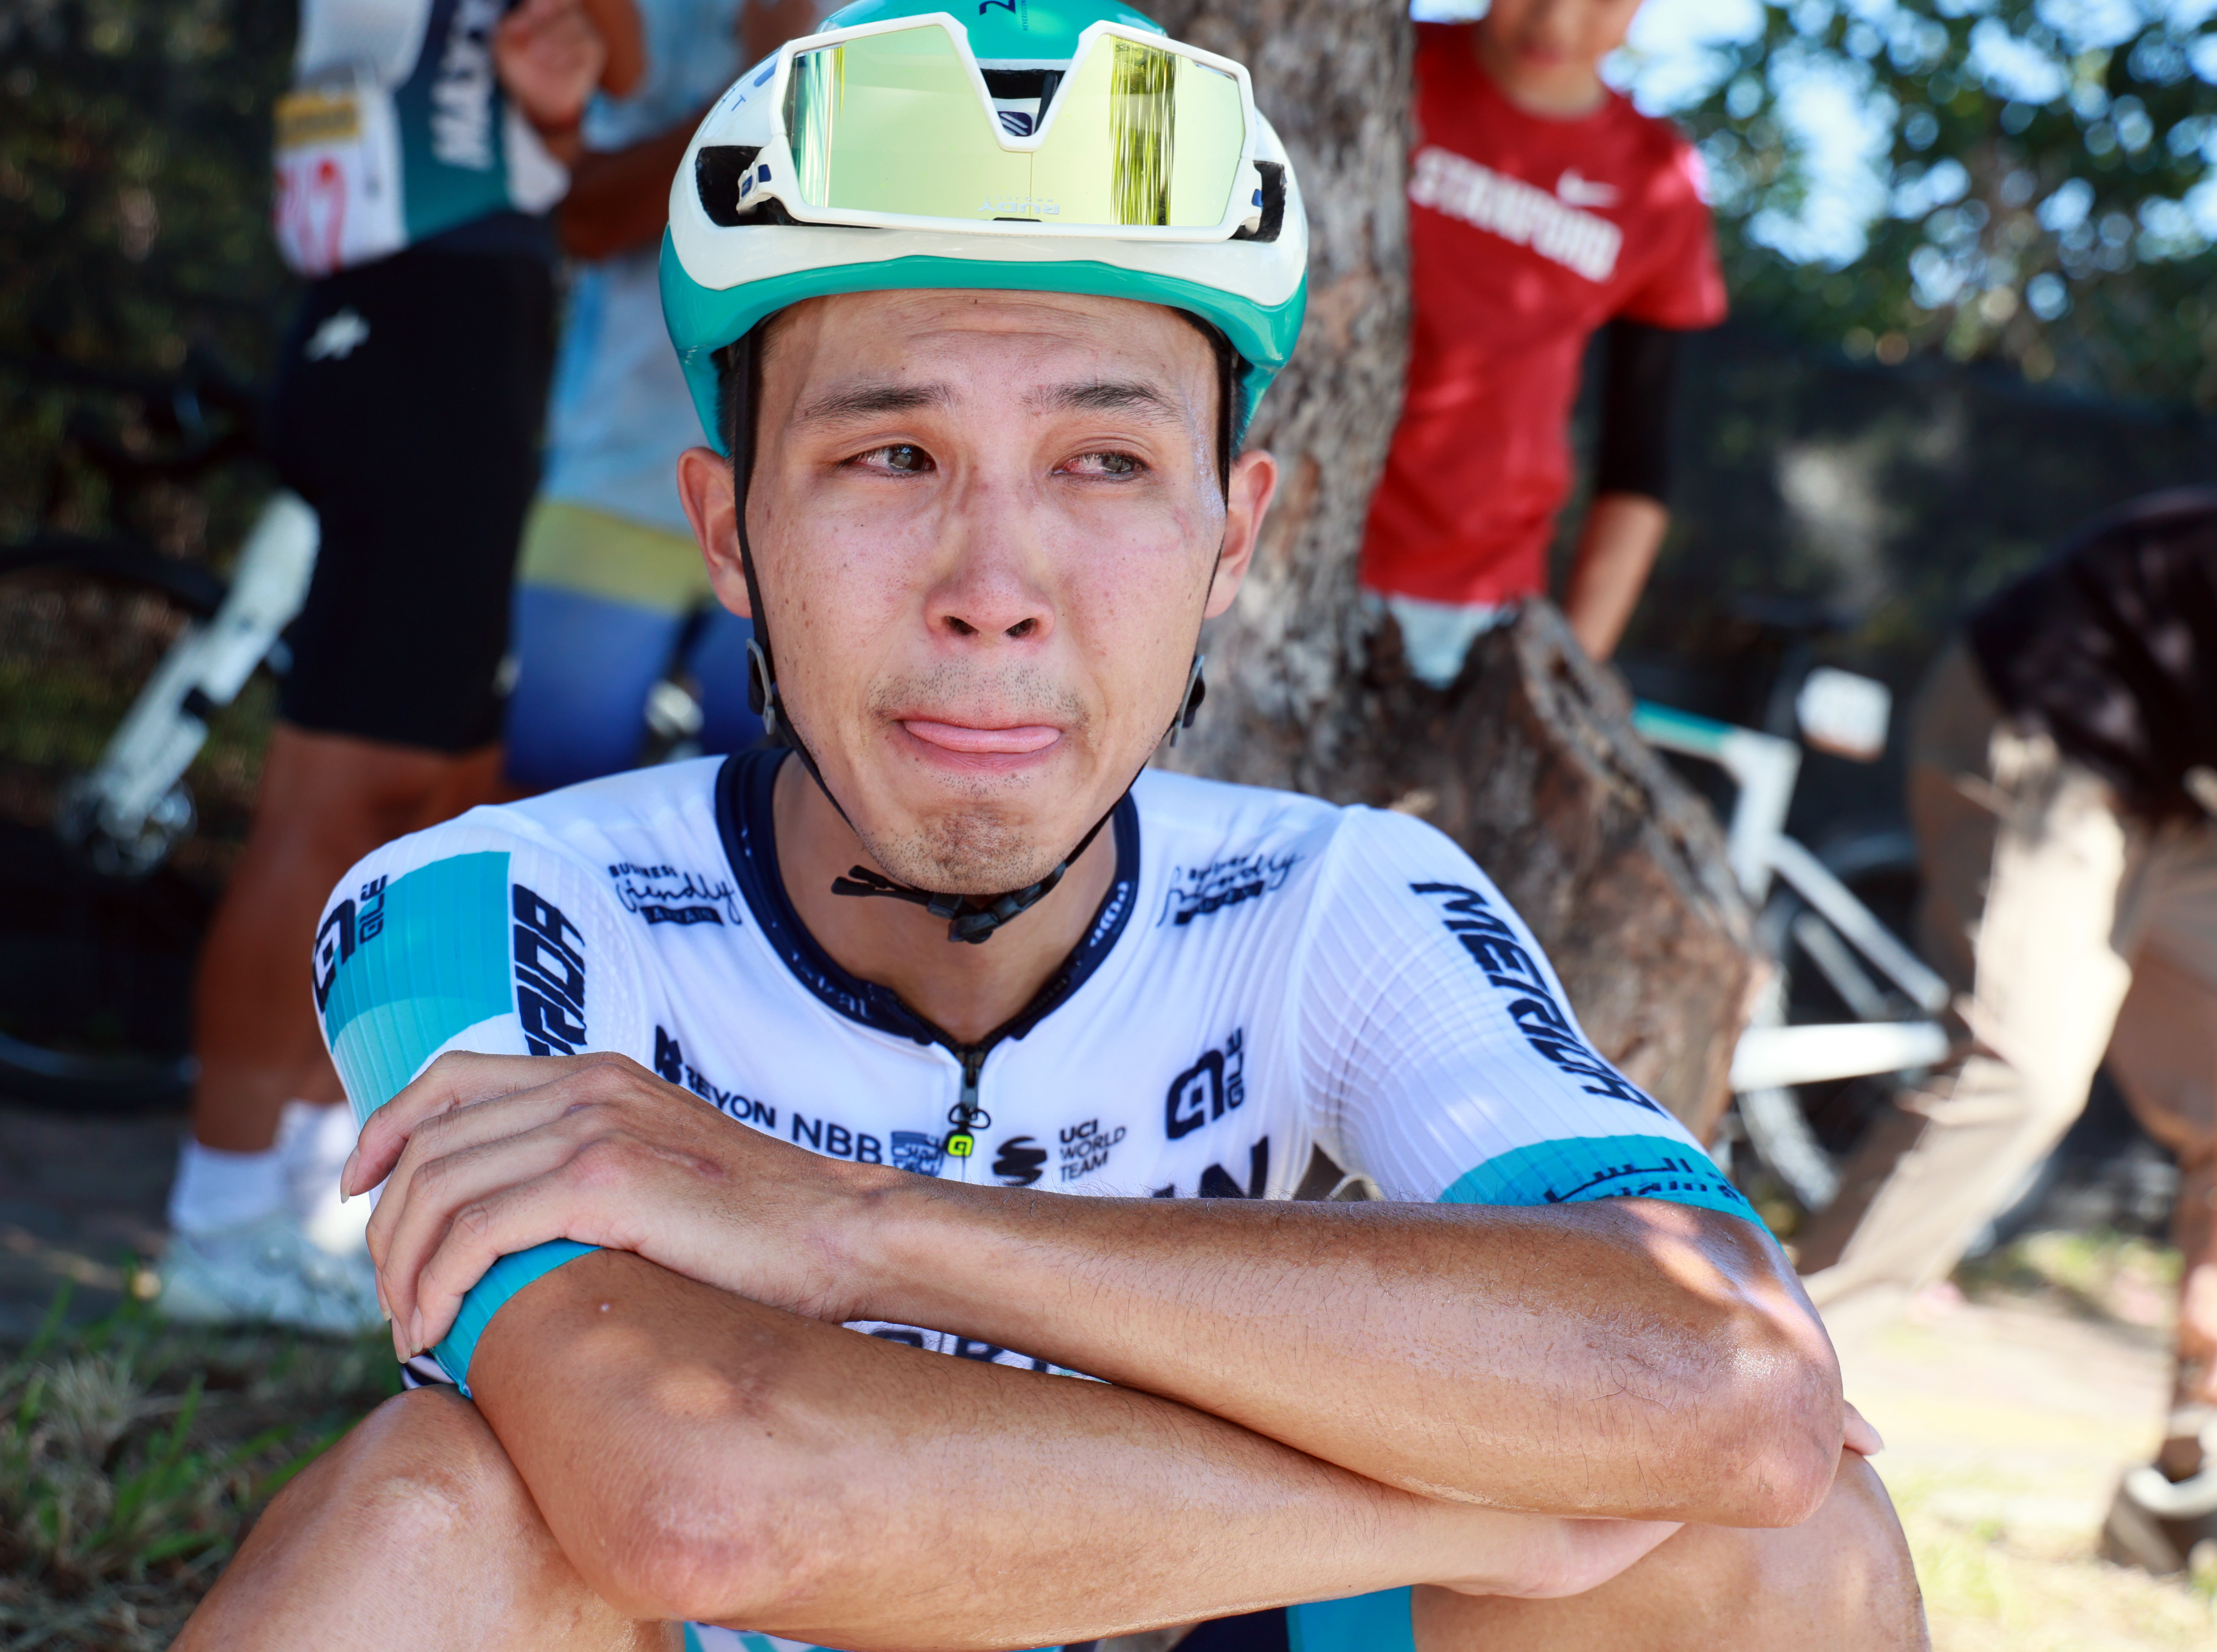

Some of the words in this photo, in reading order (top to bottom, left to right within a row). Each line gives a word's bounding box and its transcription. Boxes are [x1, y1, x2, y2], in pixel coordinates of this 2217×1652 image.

[977, 201, 1060, 215] RUDY
[1408, 883, 1671, 1120] MERIDA
[792, 1113, 882, 1165] NBB
[1060, 1118, 1098, 1143] UCI
[1060, 1126, 1127, 1159] WORLD
[1060, 1151, 1108, 1182] TEAM
